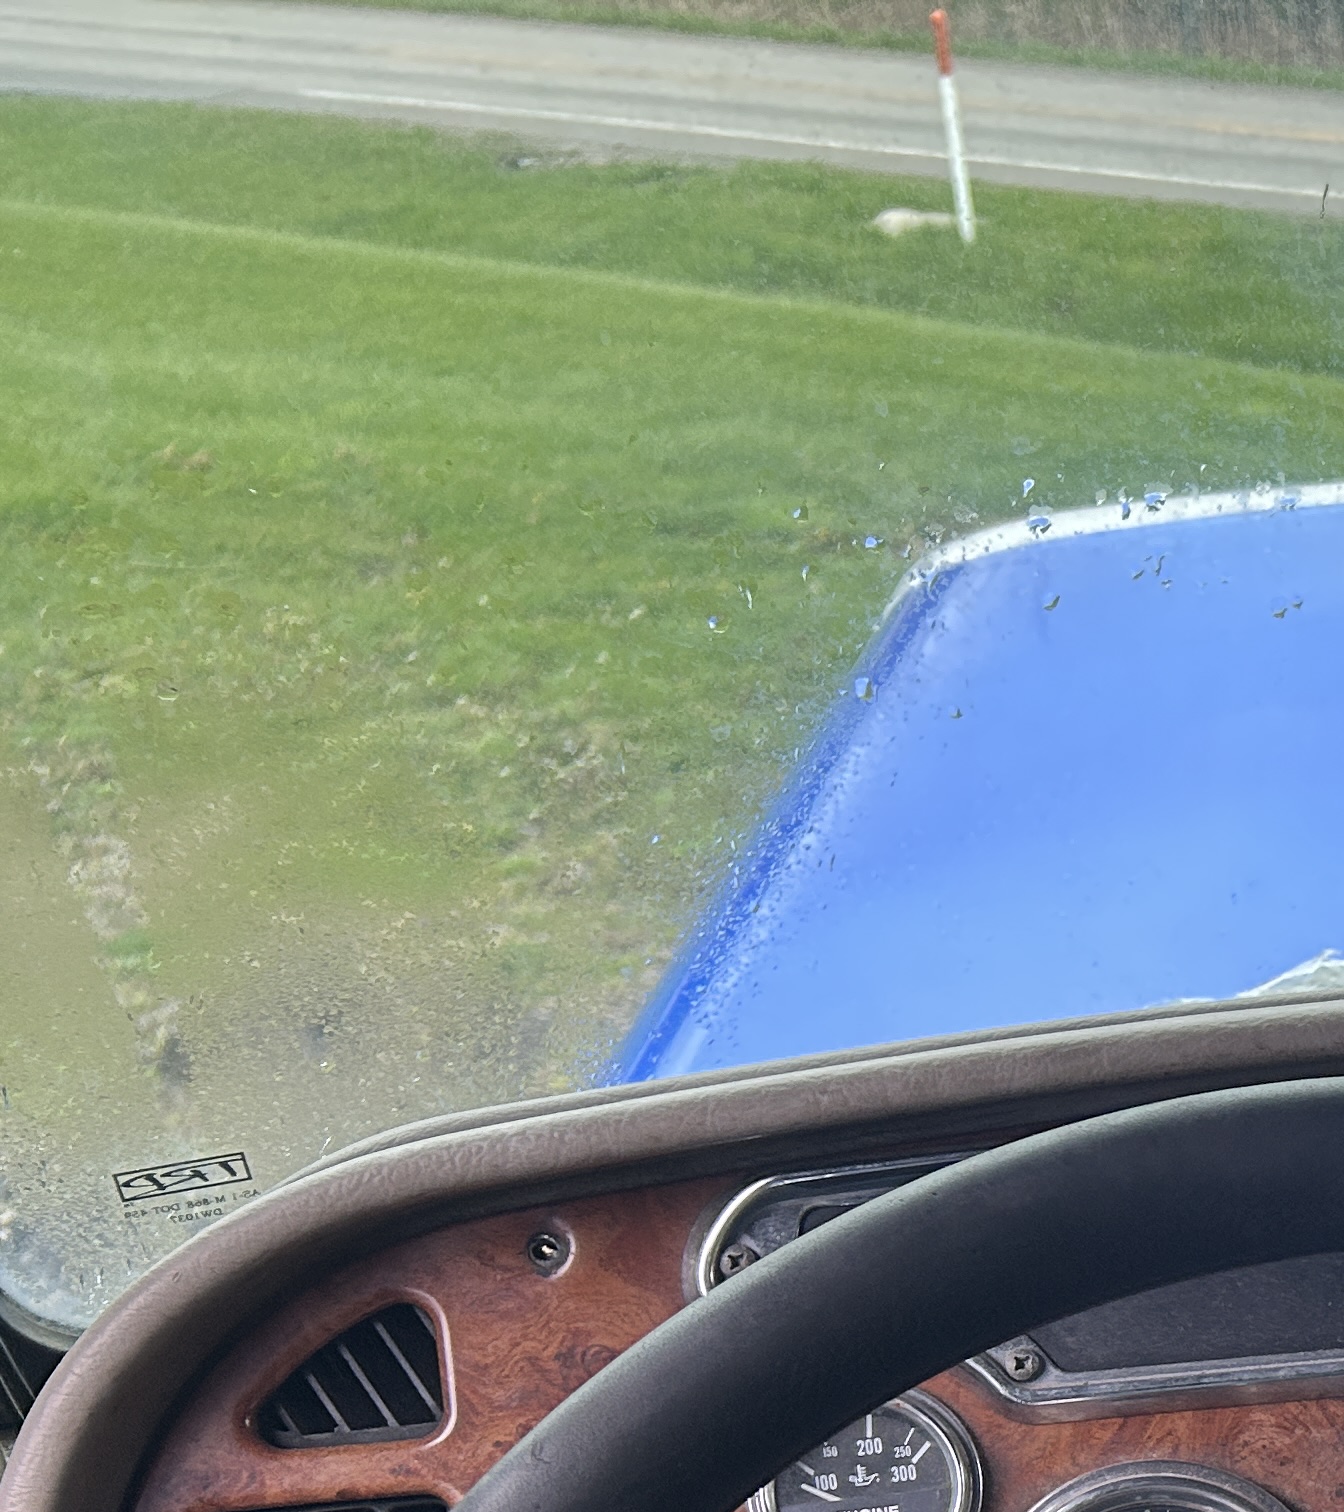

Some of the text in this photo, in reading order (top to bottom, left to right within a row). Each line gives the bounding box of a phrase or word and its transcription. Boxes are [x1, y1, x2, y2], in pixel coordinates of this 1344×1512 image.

[822, 1446, 838, 1458] 150
[856, 1437, 883, 1457] 200
[894, 1446, 912, 1458] 250
[814, 1473, 838, 1491] 100
[890, 1464, 916, 1483] 300
